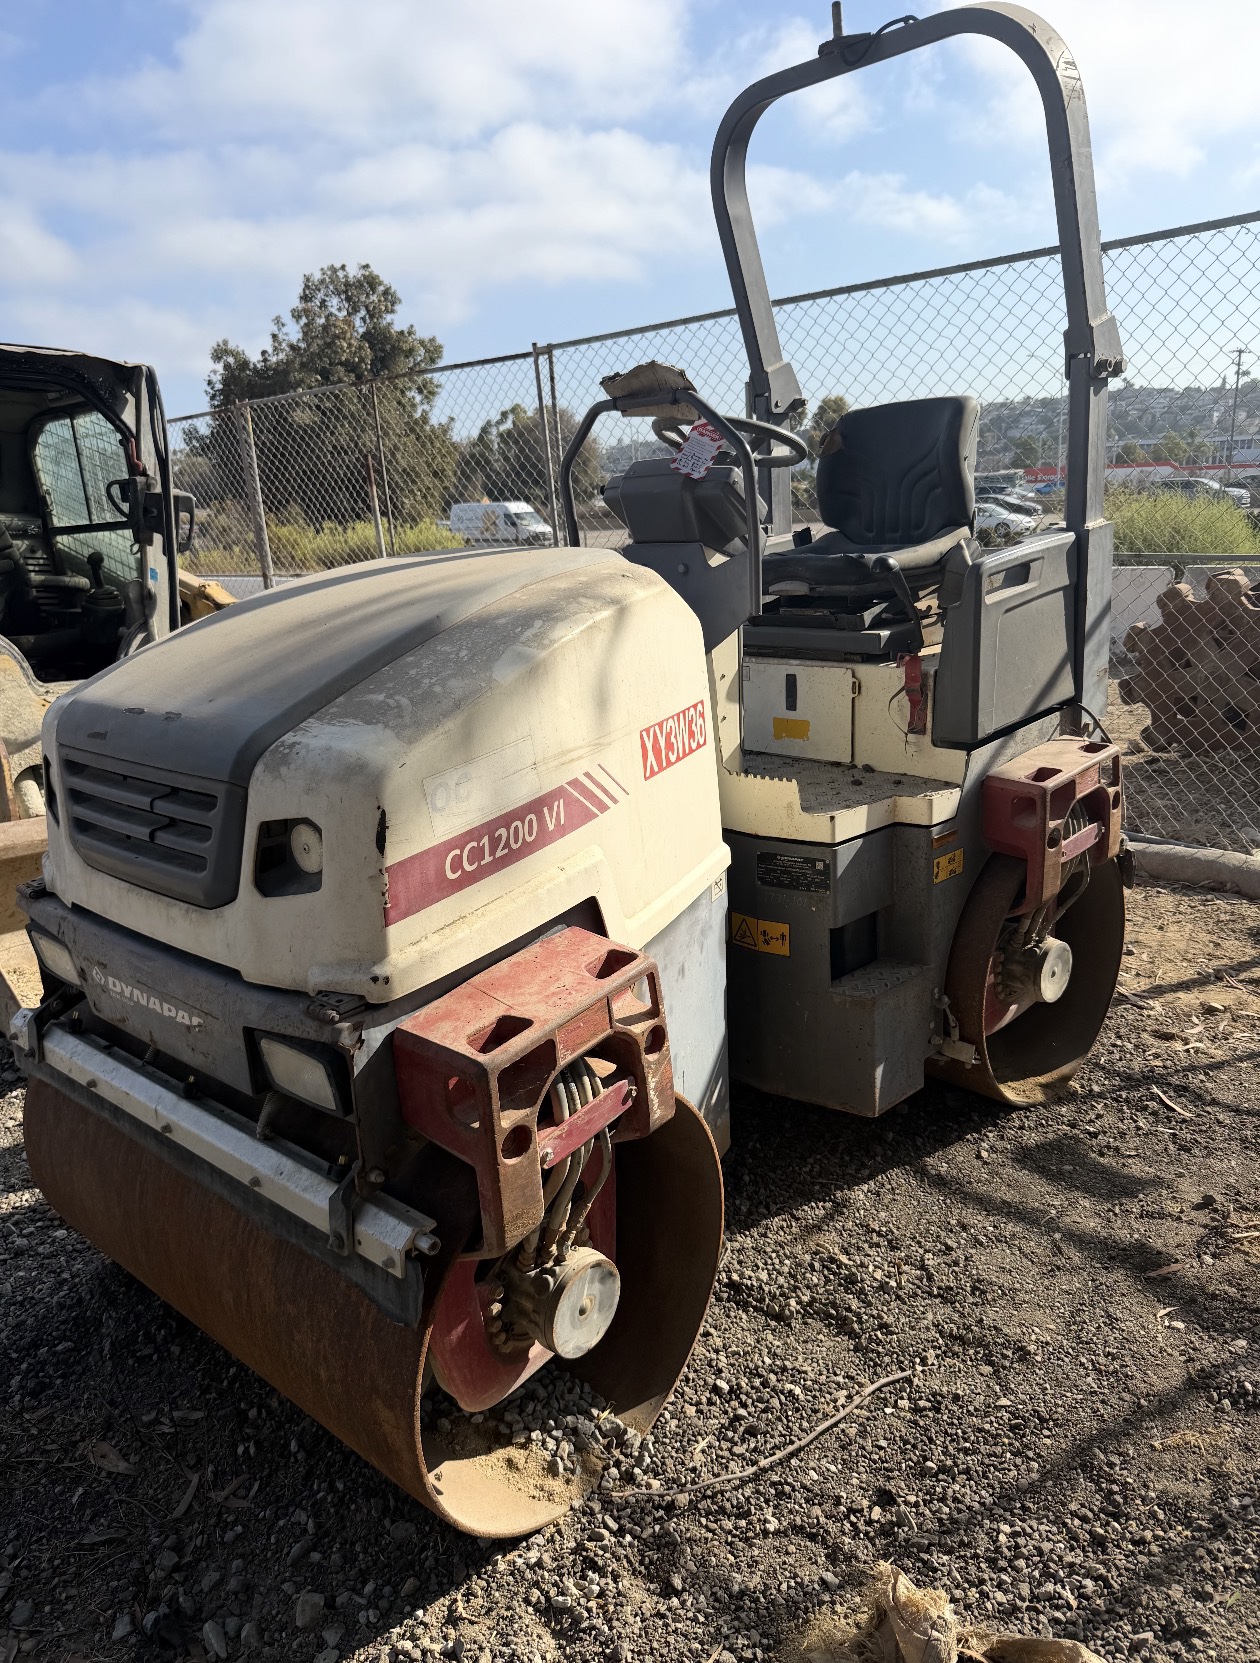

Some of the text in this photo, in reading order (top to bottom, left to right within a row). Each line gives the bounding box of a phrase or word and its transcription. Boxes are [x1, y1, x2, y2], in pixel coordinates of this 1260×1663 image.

[641, 701, 706, 778] XY3W36
[445, 798, 565, 879] CC1200 VI
